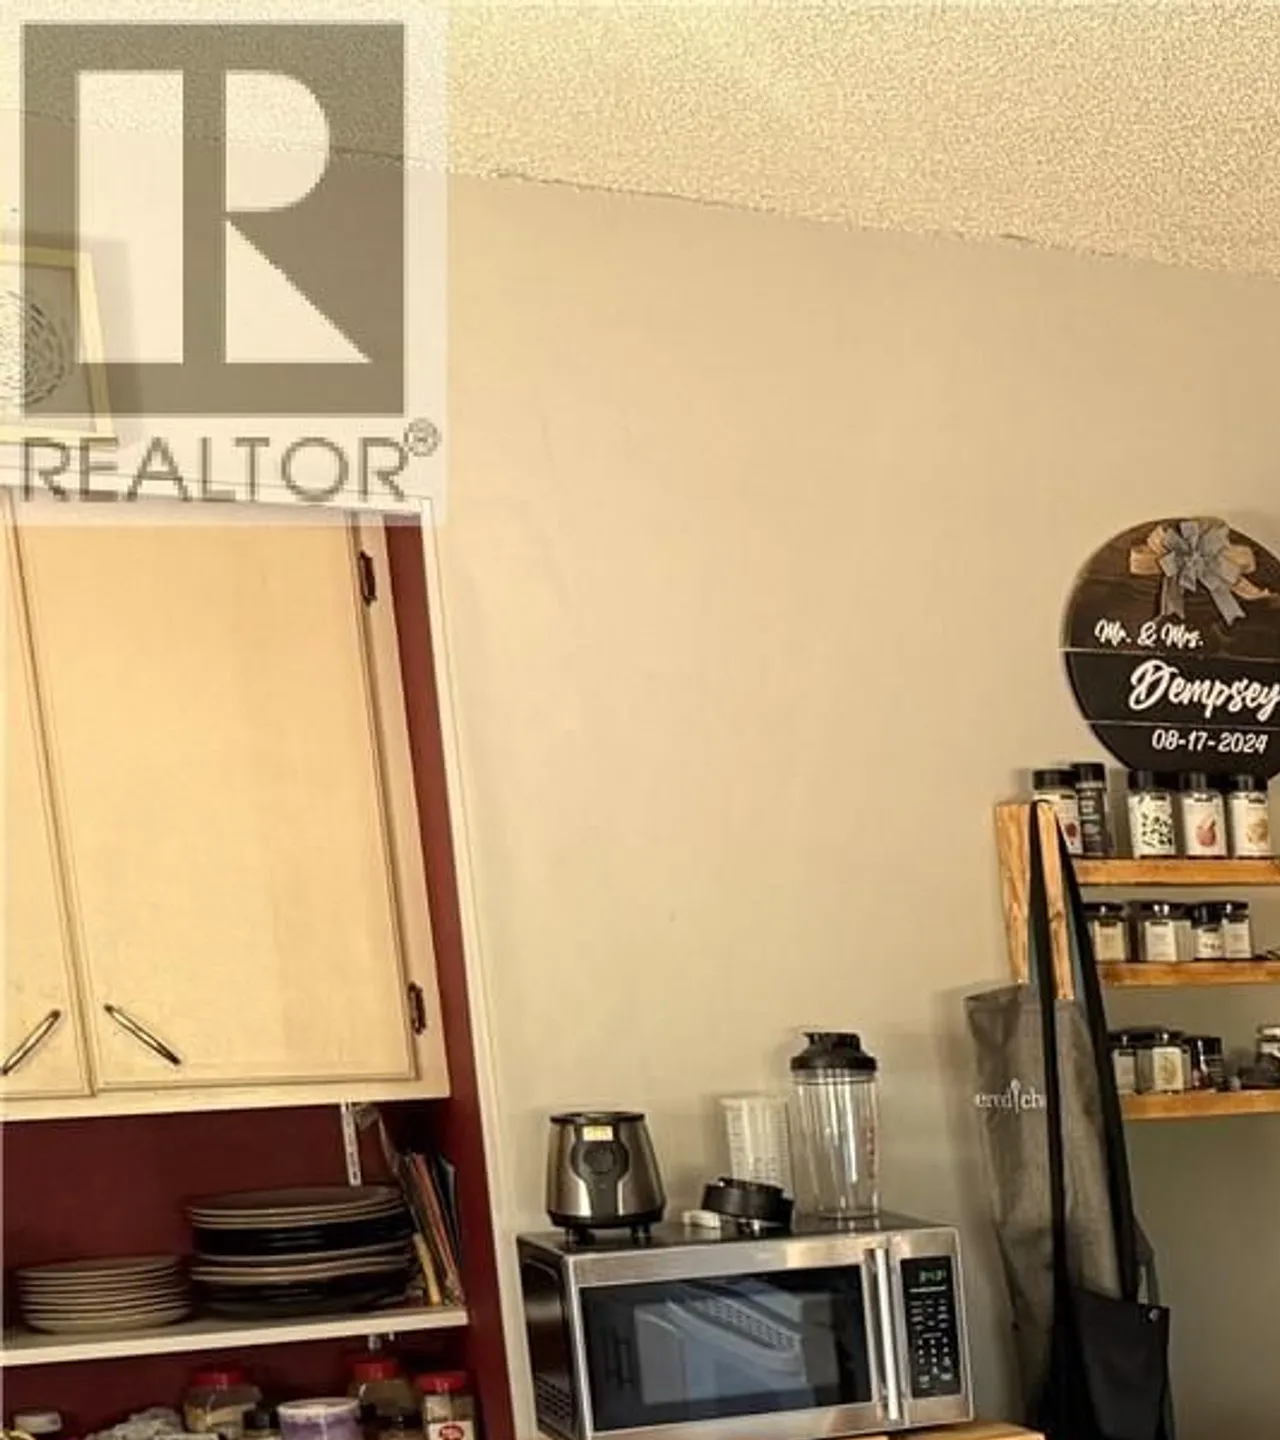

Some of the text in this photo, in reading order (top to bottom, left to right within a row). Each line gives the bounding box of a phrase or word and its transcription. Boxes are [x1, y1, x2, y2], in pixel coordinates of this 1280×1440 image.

[1094, 618, 1204, 650] Mr. & Mrs.
[1151, 729, 1270, 754] 08-17-2024
